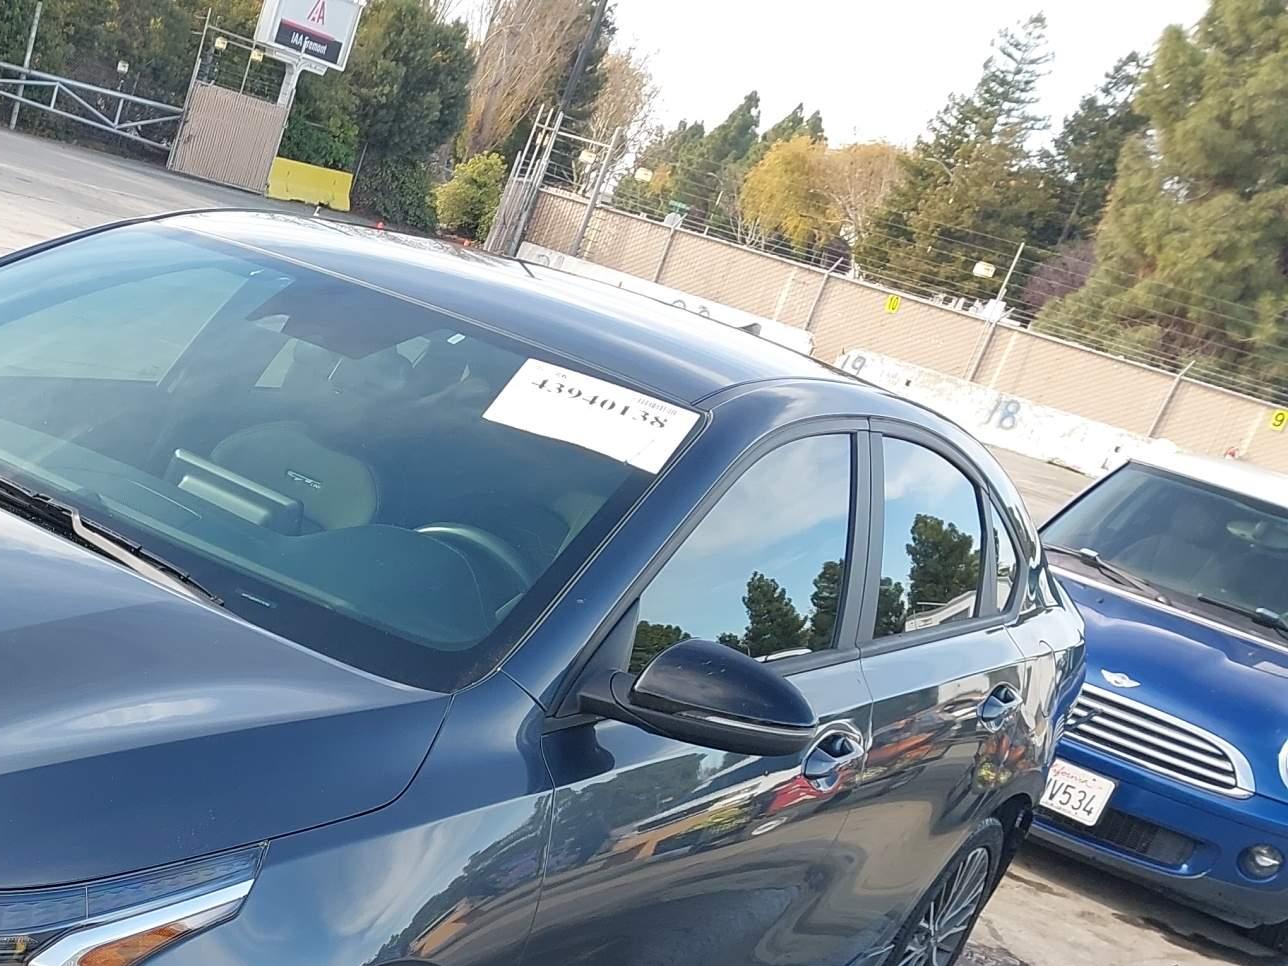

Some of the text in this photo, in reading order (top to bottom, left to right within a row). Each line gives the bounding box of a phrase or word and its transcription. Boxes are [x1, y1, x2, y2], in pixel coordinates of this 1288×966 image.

[290, 31, 328, 55] IAA Fremont
[888, 296, 899, 311] 10
[531, 378, 668, 429] 43940138
[983, 393, 1021, 430] 18
[1272, 412, 1285, 427] 9
